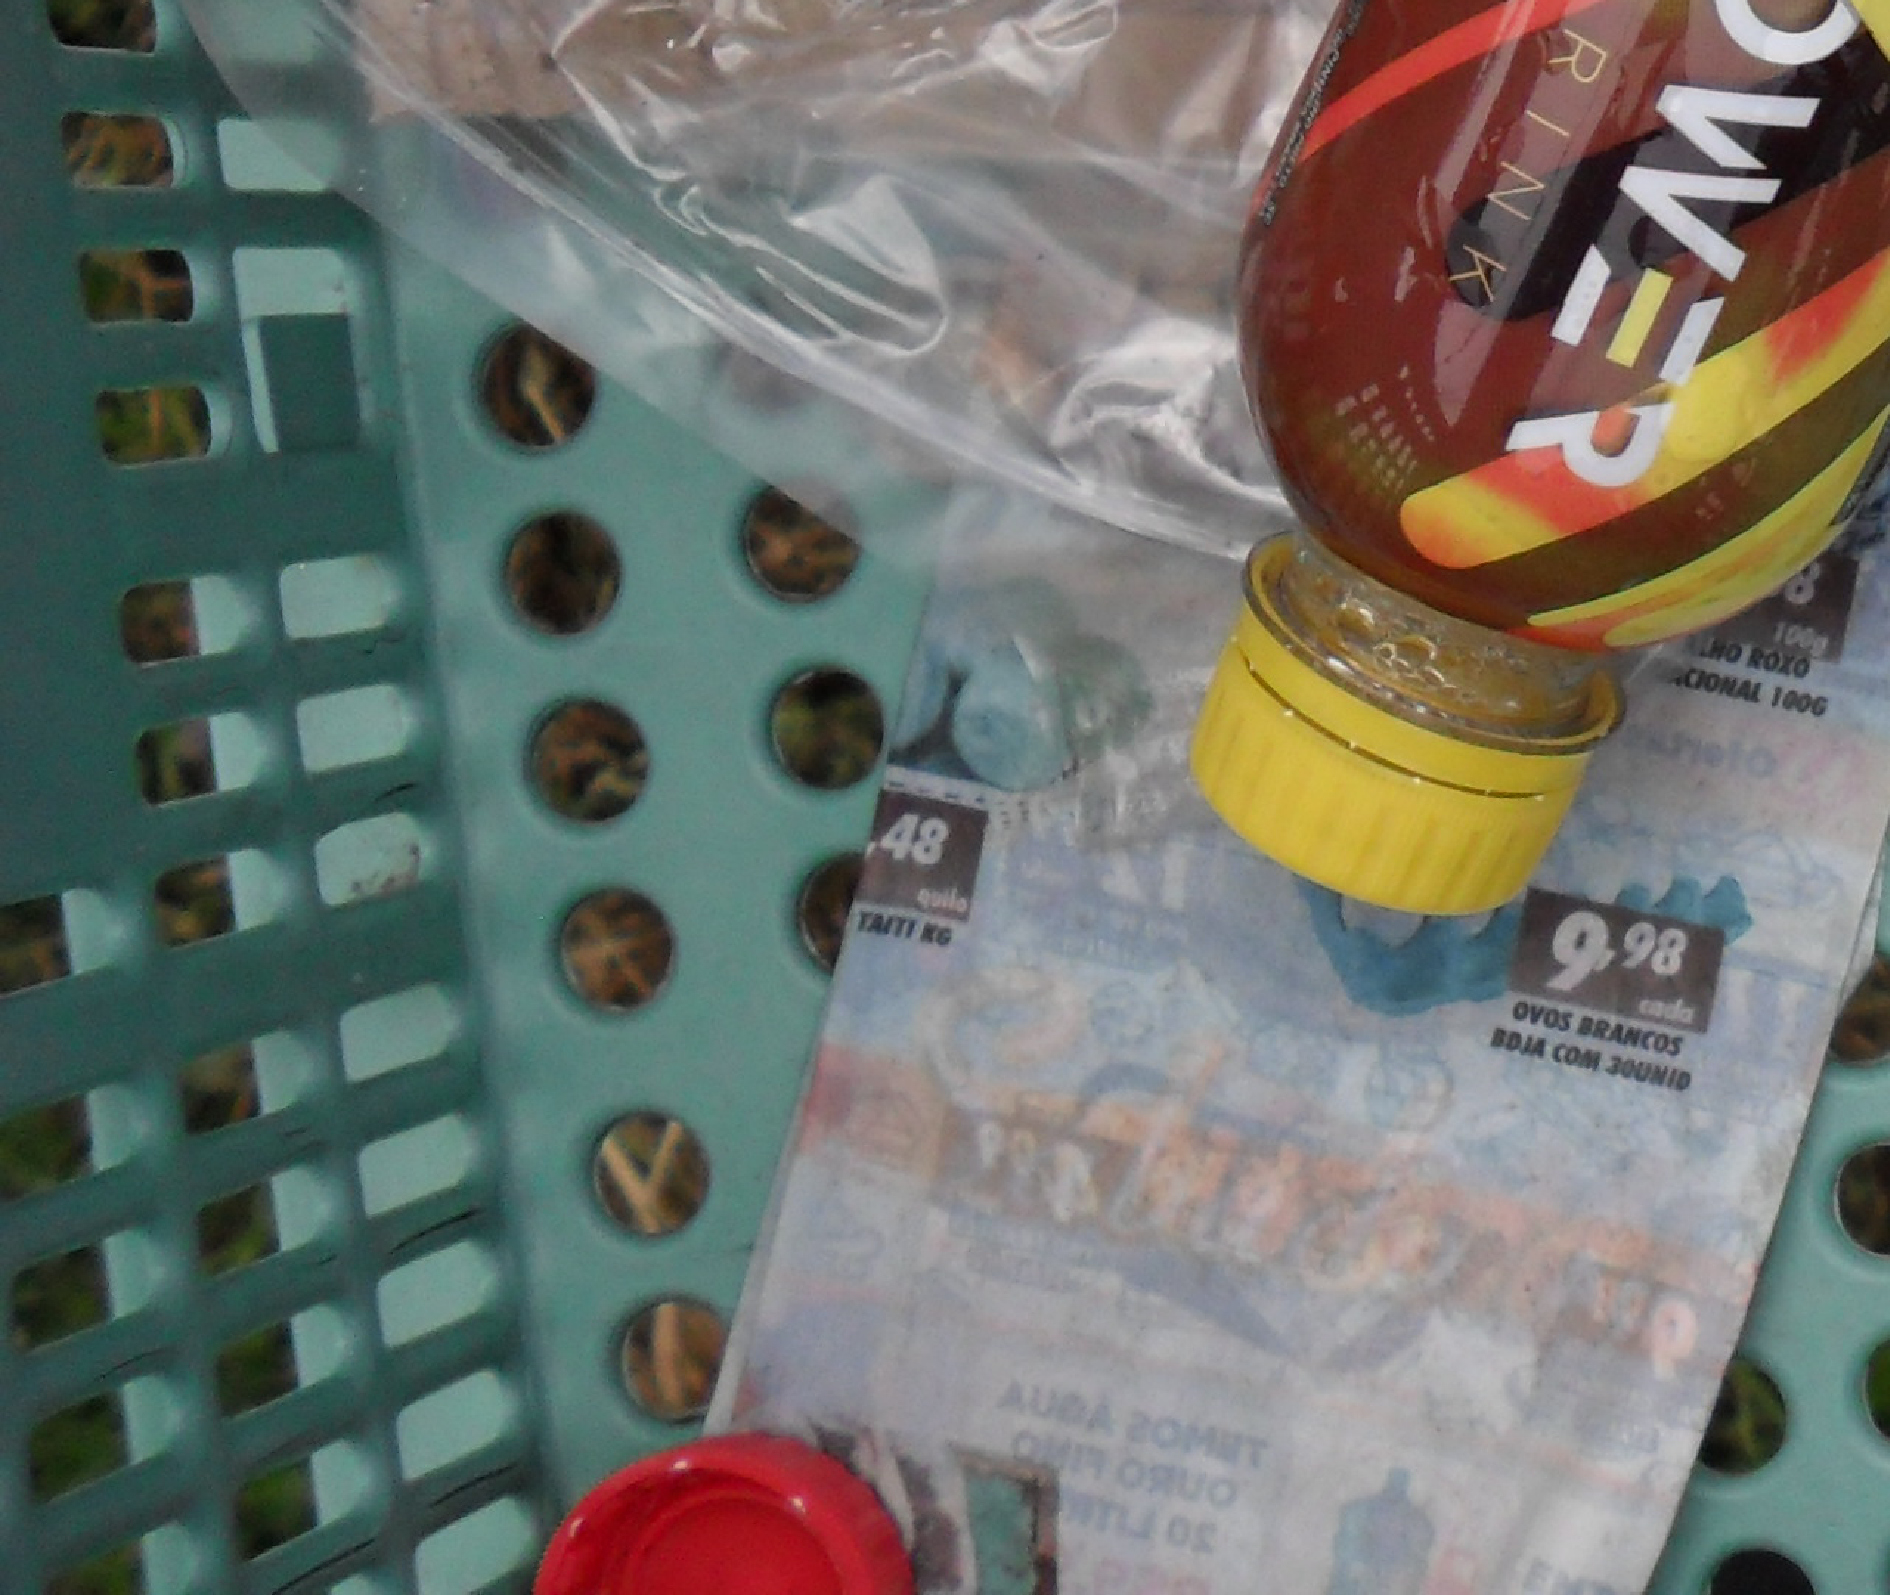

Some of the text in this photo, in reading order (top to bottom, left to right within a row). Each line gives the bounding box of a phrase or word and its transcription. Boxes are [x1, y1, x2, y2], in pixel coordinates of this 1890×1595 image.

[1746, 645, 1811, 679] ROXO
[1770, 685, 1830, 717] 100G
[1511, 1000, 1684, 1057] OVOS BRANCOS
[1551, 1042, 1603, 1072] COM
[1604, 1056, 1692, 1091] 30UNID
